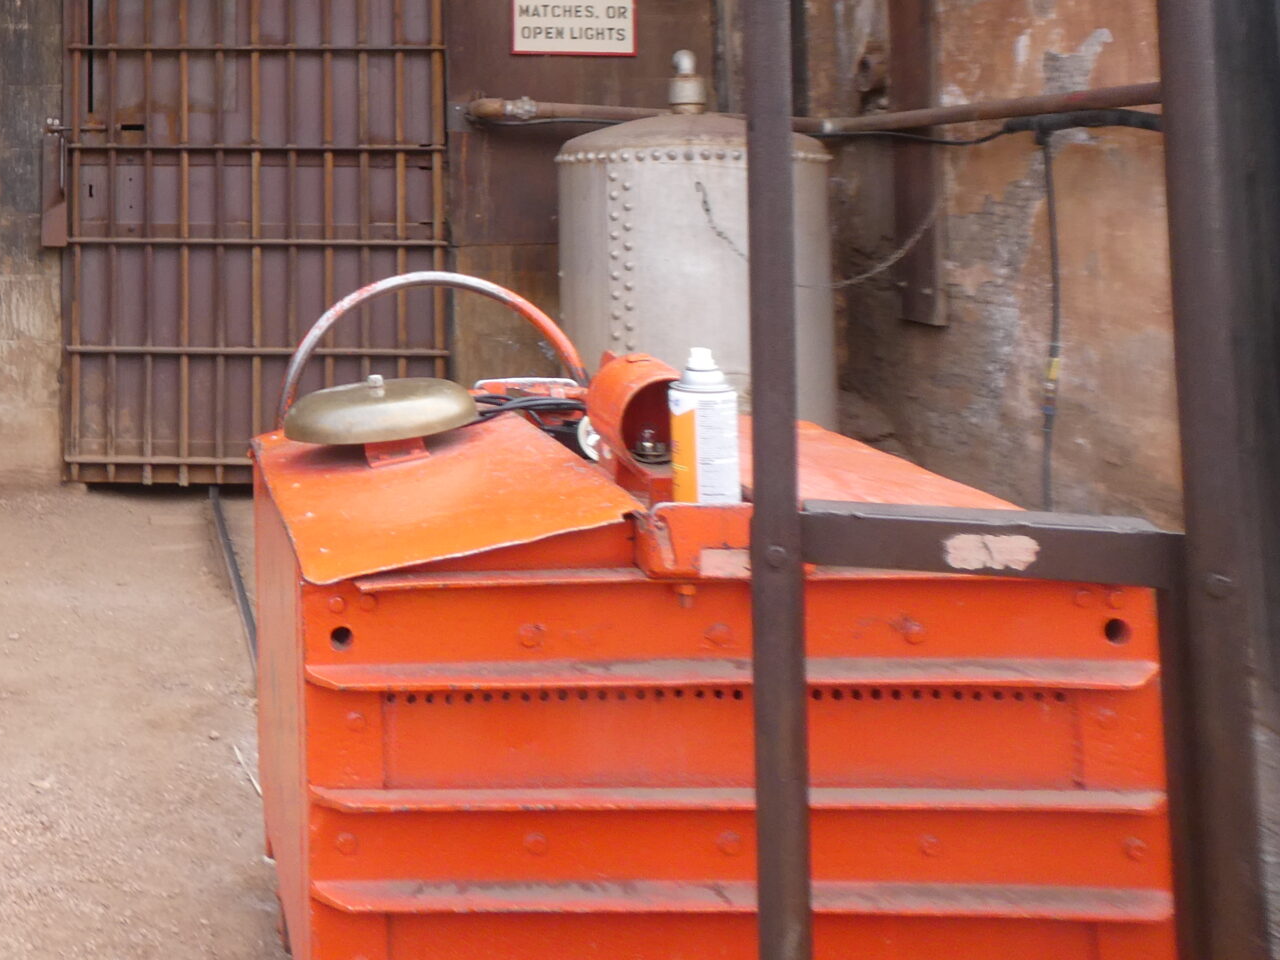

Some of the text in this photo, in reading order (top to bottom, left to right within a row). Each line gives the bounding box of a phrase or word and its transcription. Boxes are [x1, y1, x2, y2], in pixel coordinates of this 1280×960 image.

[606, 5, 628, 19] OR
[521, 25, 627, 42] OPEN LIGHTS
